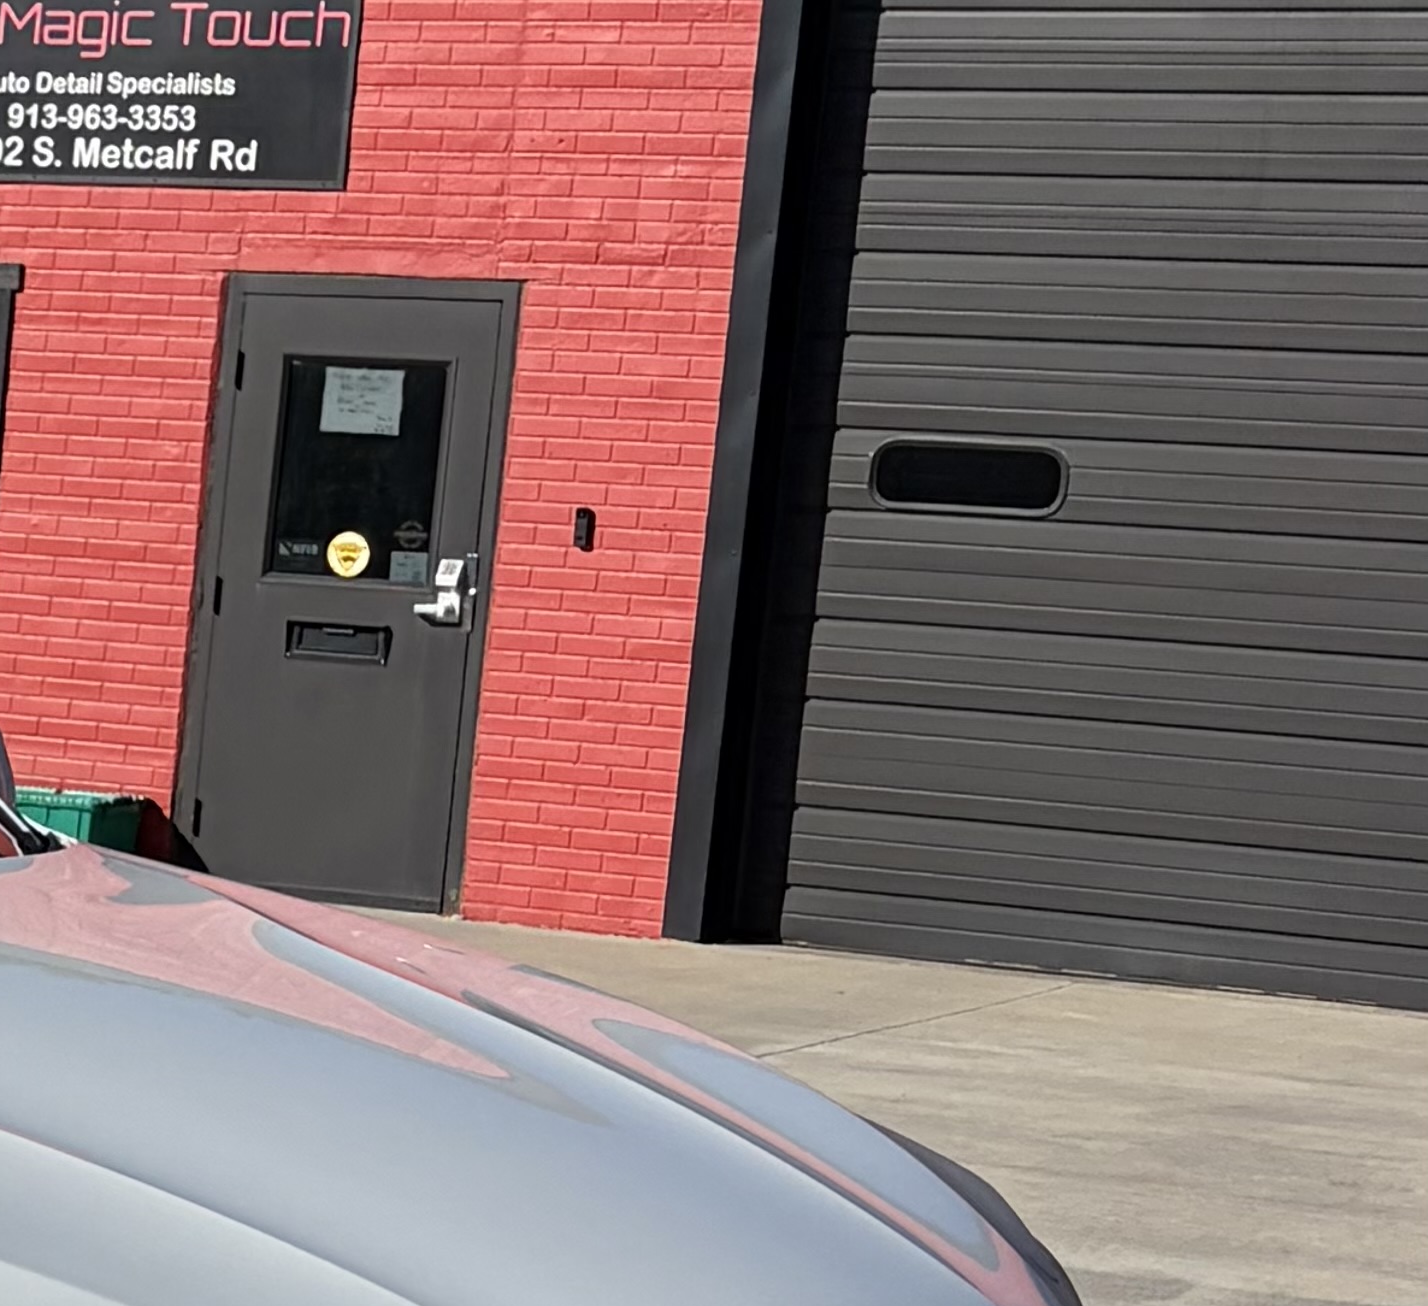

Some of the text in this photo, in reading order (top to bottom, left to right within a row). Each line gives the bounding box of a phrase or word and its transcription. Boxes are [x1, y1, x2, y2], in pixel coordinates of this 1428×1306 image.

[170, 0, 351, 47] Touch
[35, 70, 103, 95] Detail
[106, 71, 236, 100] Specialists
[7, 102, 196, 131] 913-963-3353
[31, 136, 62, 168] S.
[72, 137, 200, 170] Metcalf
[209, 139, 258, 171] Rd
